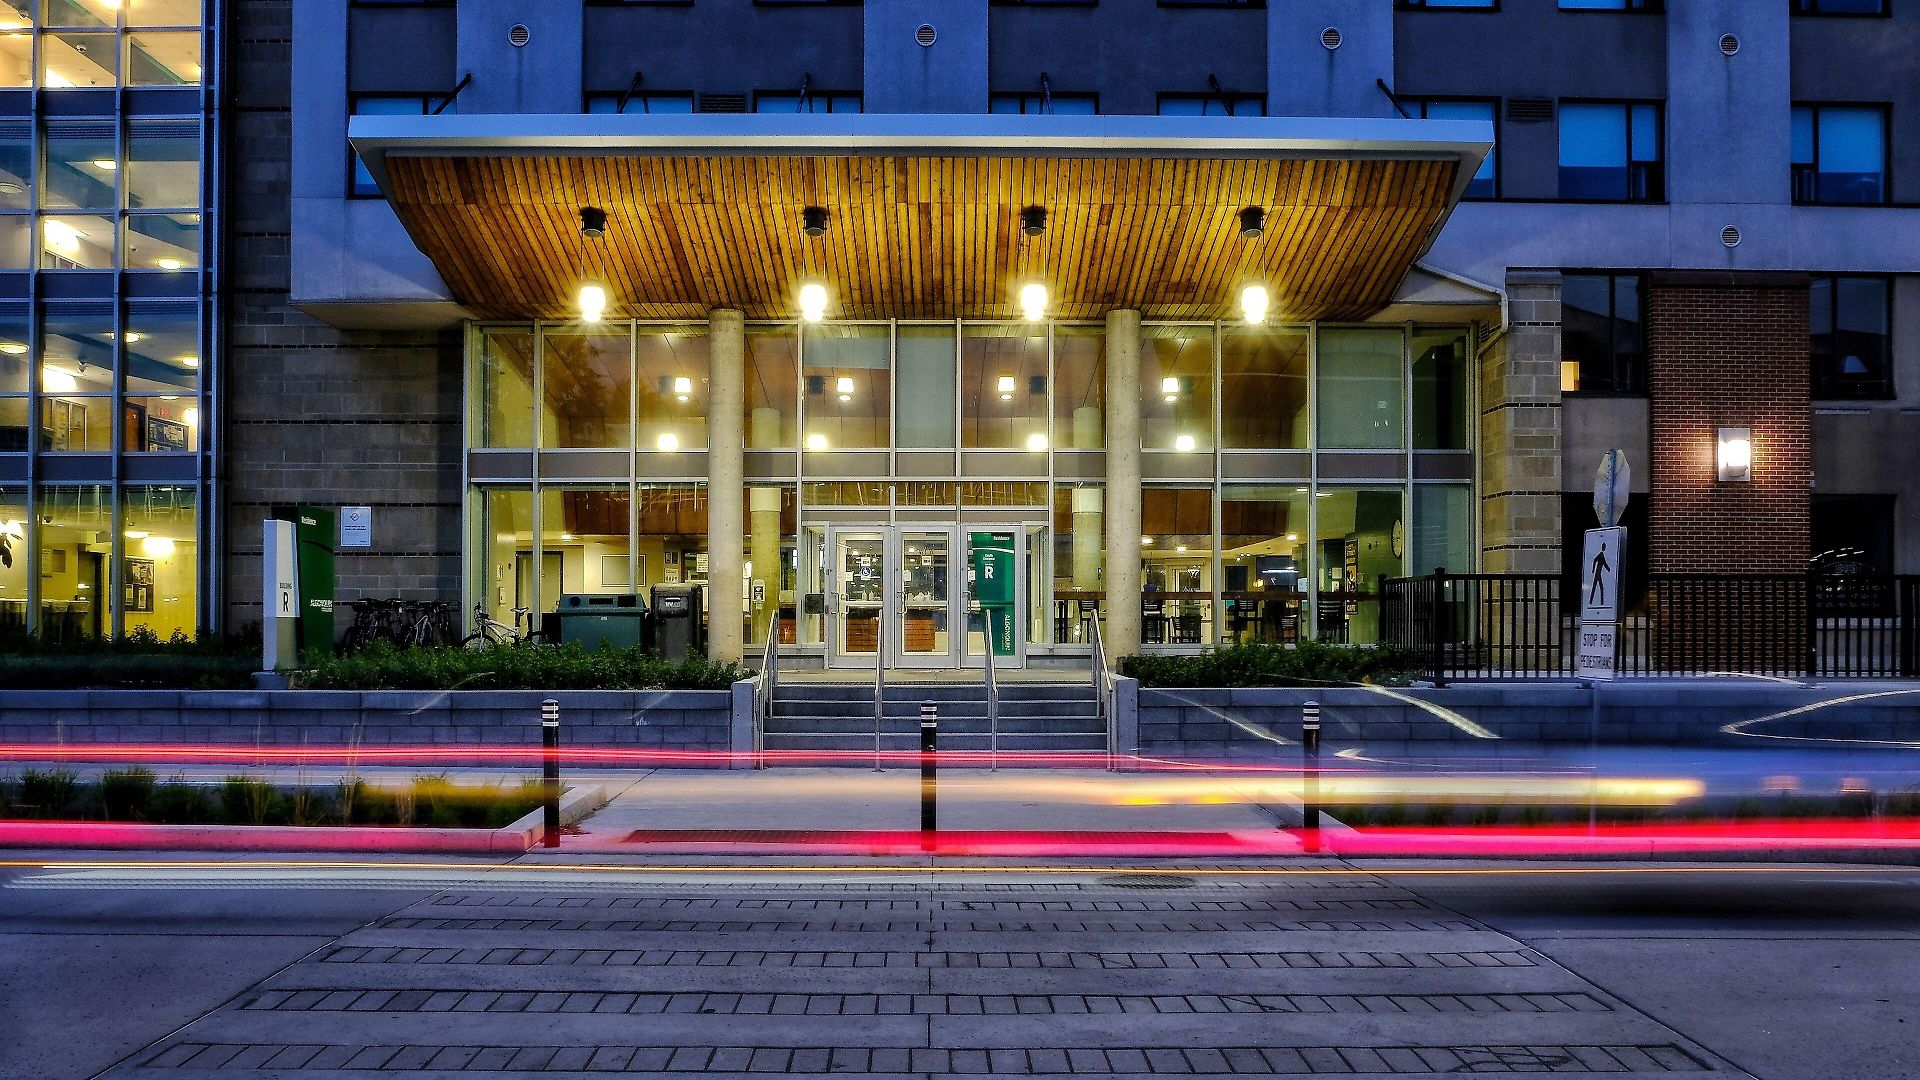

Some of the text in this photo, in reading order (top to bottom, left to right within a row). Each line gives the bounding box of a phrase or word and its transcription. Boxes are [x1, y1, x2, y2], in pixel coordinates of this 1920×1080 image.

[984, 565, 994, 579] R
[283, 591, 289, 612] R
[1583, 633, 1612, 648] STOP FOR
[1580, 654, 1612, 670] PEDESTRIANS
